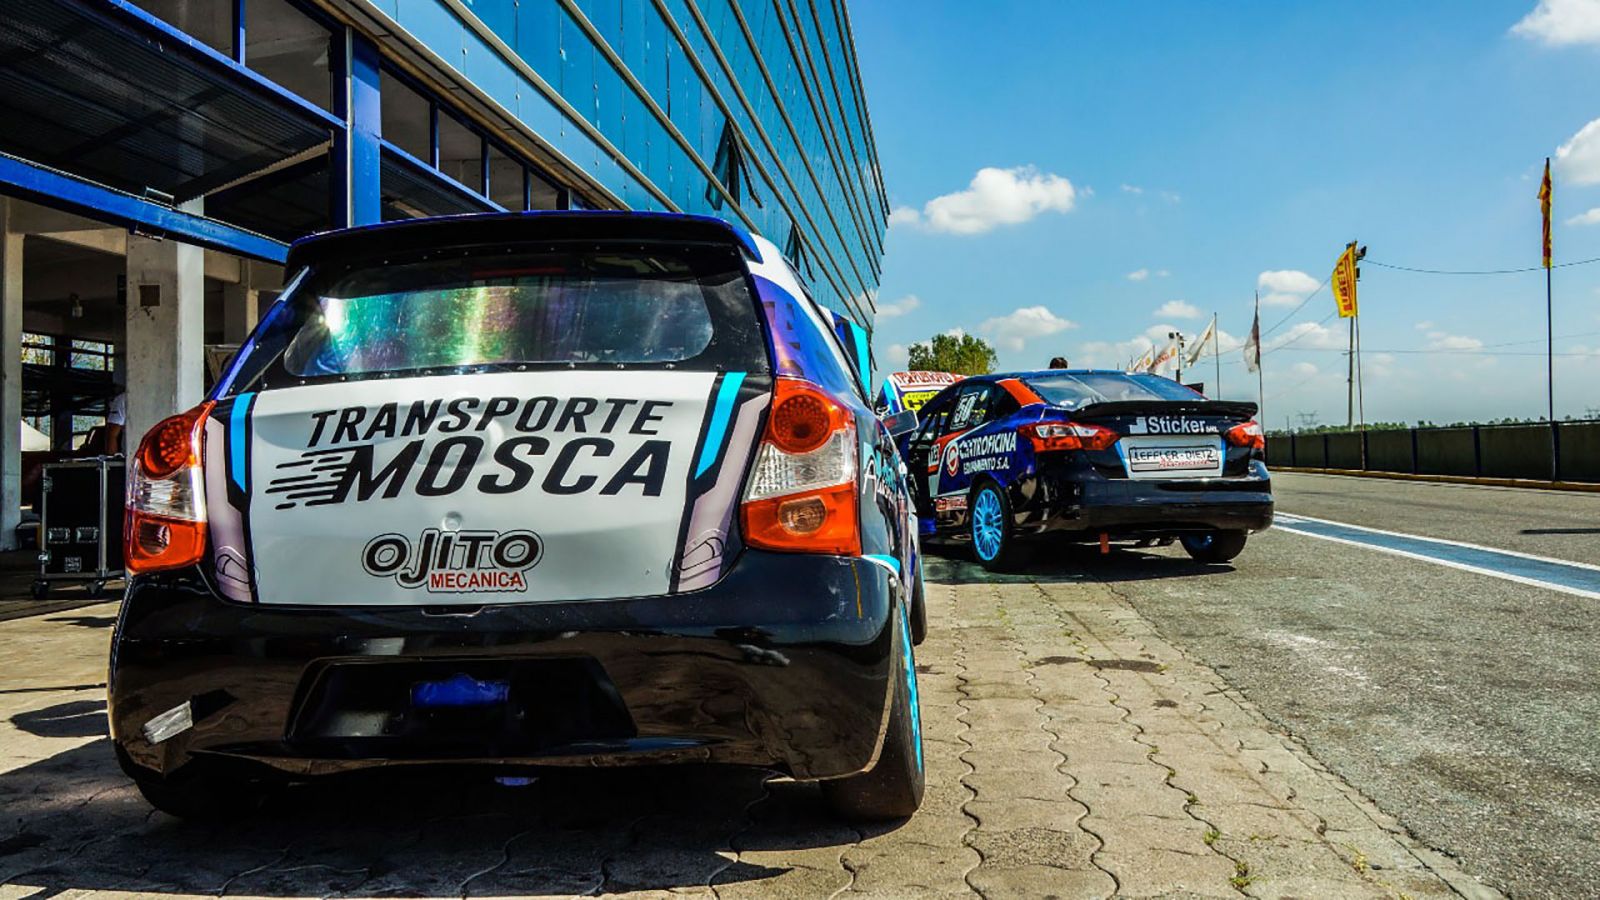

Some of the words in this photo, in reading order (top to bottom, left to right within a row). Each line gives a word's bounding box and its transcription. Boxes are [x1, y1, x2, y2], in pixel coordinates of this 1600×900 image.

[307, 396, 673, 447] TRANSPORTE
[1148, 416, 1206, 434] Sticker
[331, 436, 672, 504] MOSCA
[365, 532, 540, 584] OJITO
[430, 571, 524, 588] MECANICA
